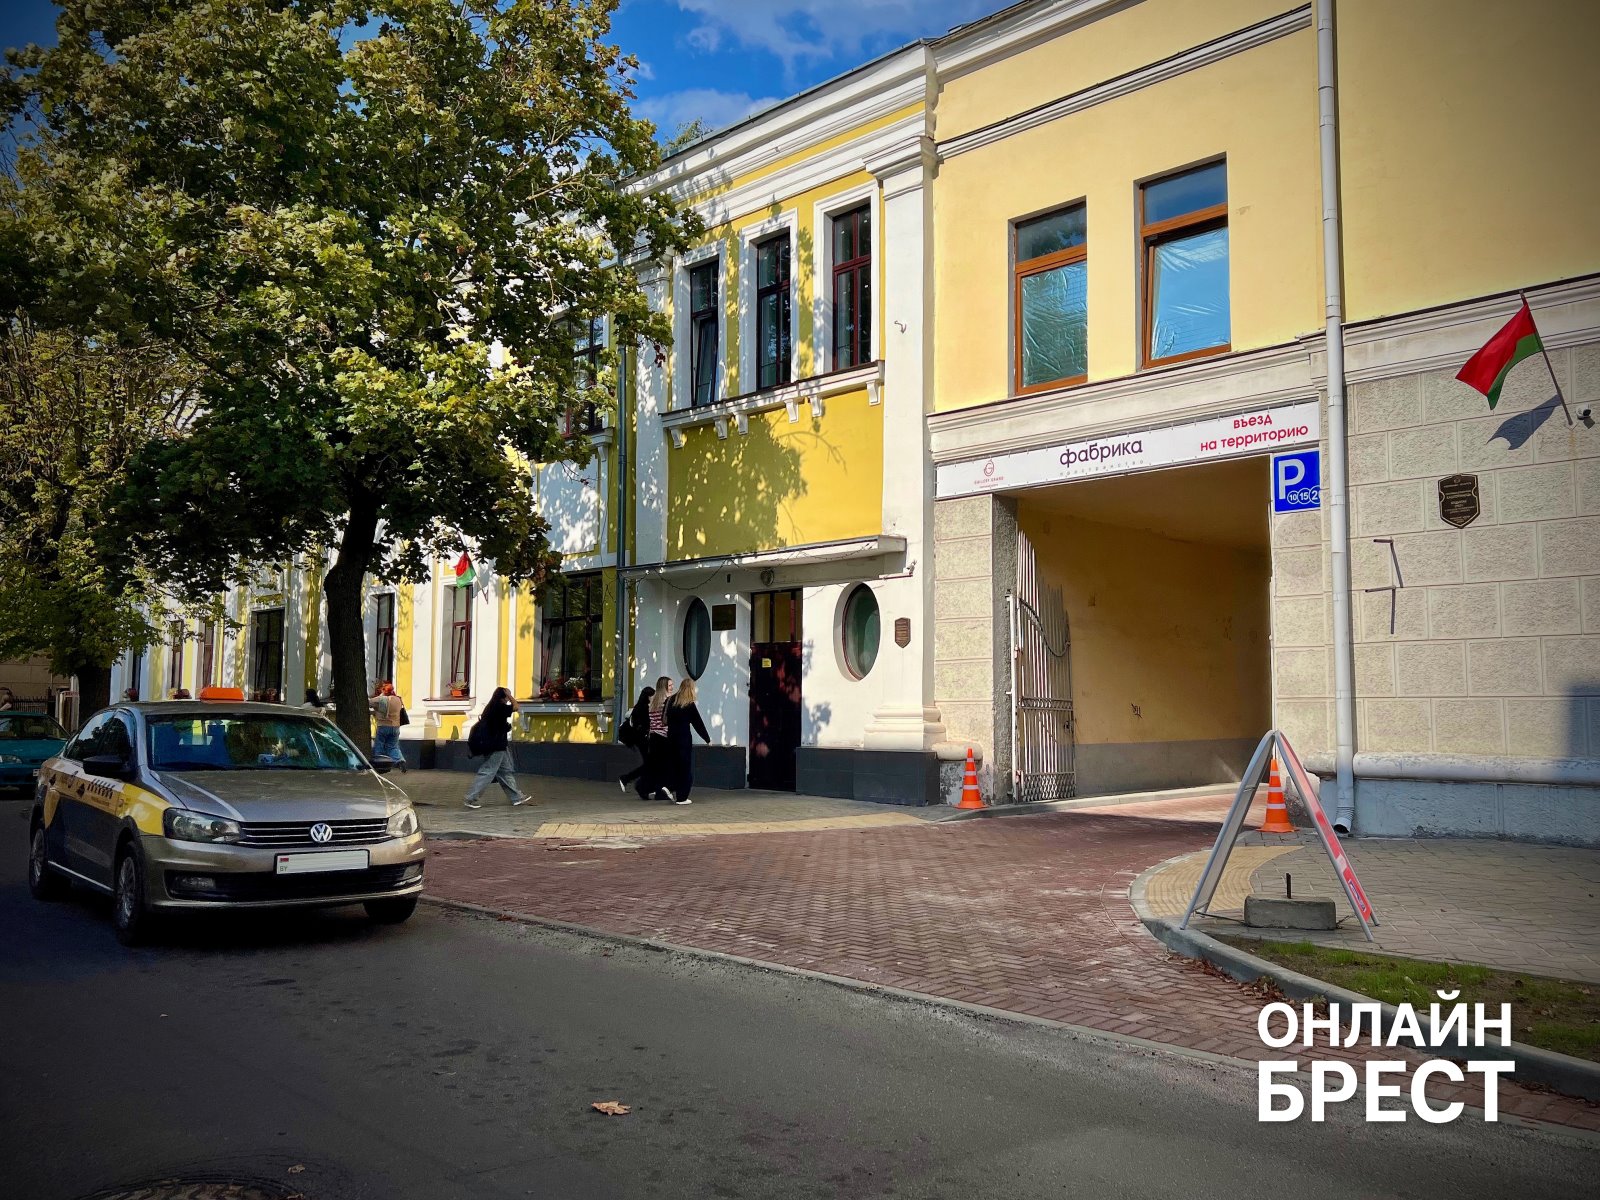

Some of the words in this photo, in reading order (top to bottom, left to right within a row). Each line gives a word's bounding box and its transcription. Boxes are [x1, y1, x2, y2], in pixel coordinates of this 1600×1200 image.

[1233, 414, 1273, 430] въезд
[1200, 439, 1217, 452] на
[1221, 425, 1309, 449] территорию
[1059, 439, 1143, 468] фабрика
[1278, 458, 1306, 500] P
[1299, 492, 1309, 501] 15
